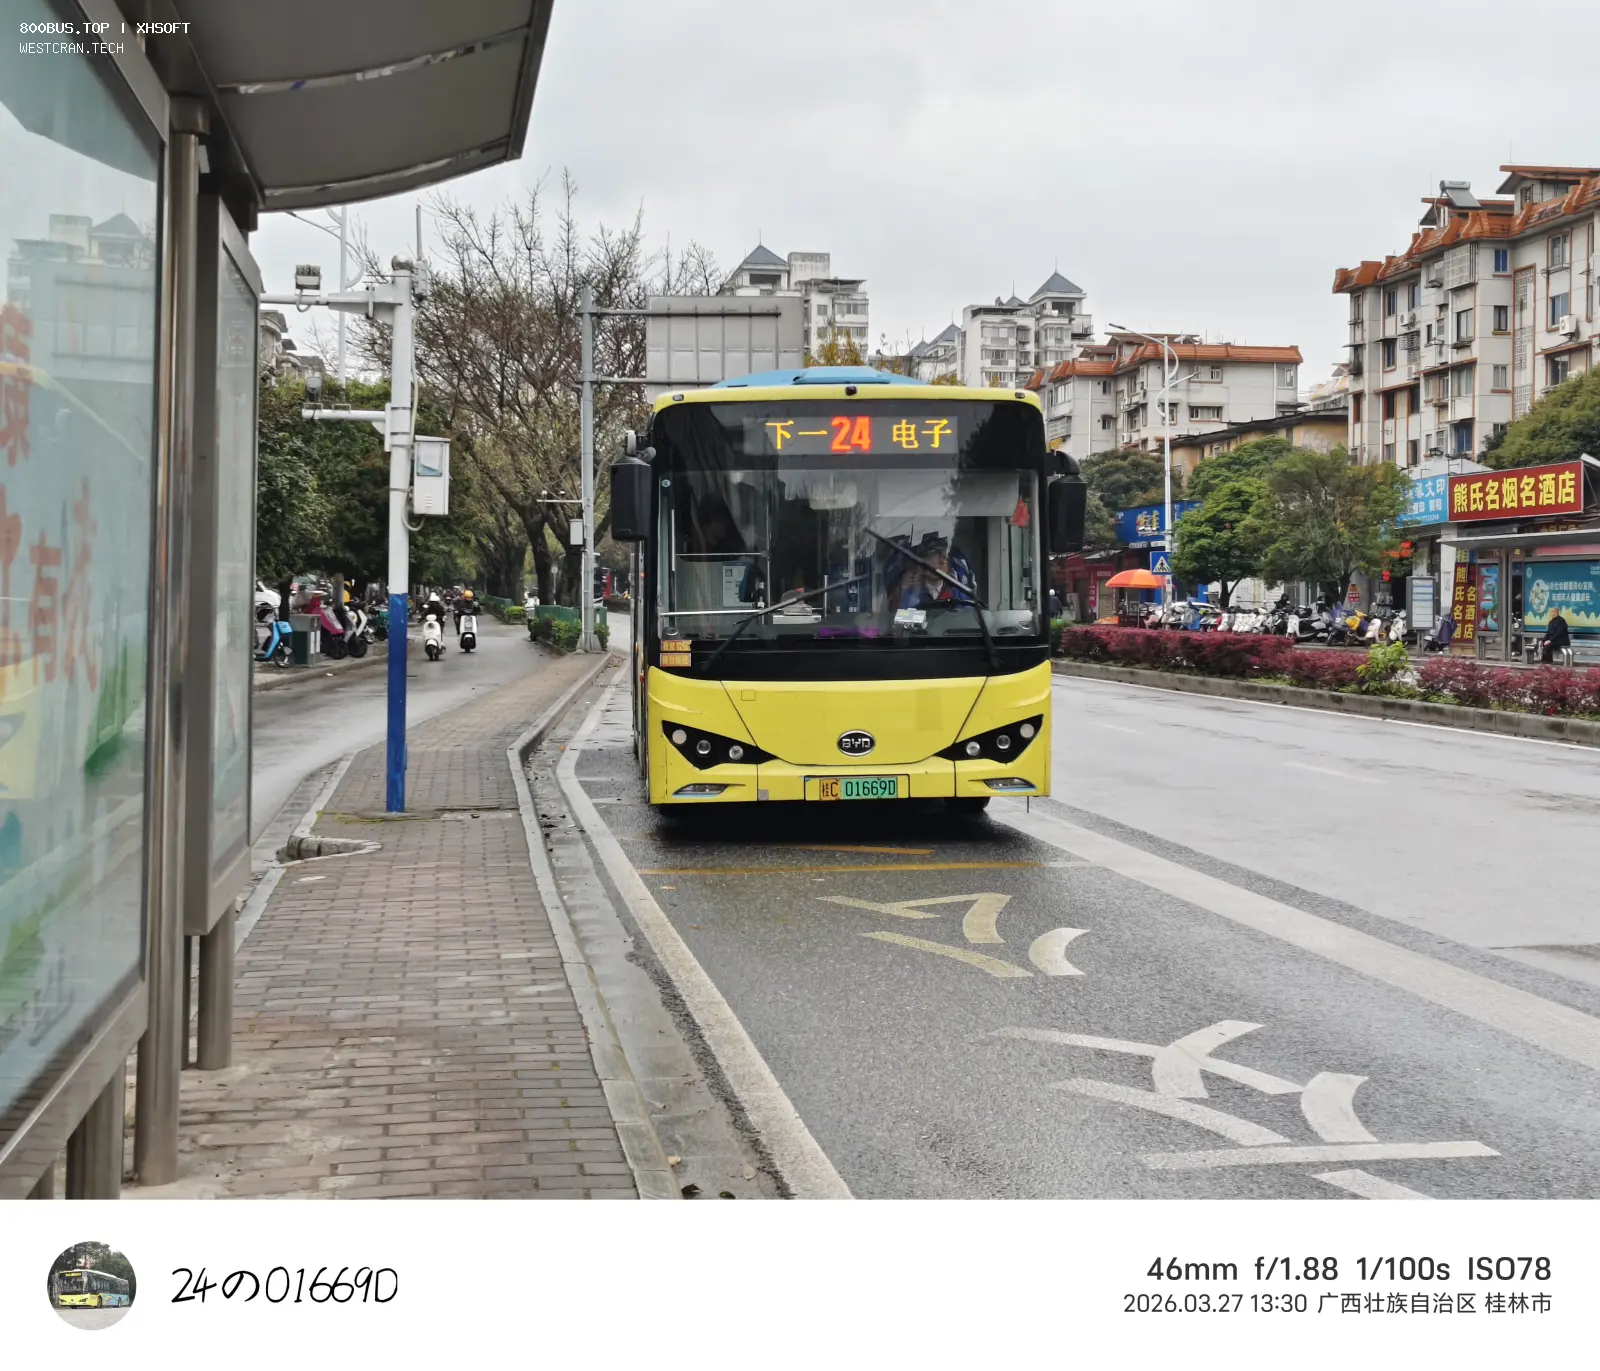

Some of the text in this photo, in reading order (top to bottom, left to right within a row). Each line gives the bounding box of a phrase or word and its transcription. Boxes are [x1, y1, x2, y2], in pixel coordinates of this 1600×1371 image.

[765, 416, 952, 452] 下一 24 电子
[1453, 471, 1576, 513] 熊氏名烟名酒店
[1464, 586, 1477, 639] 名酒店
[841, 738, 871, 749] BYD
[845, 780, 896, 797] 01669D
